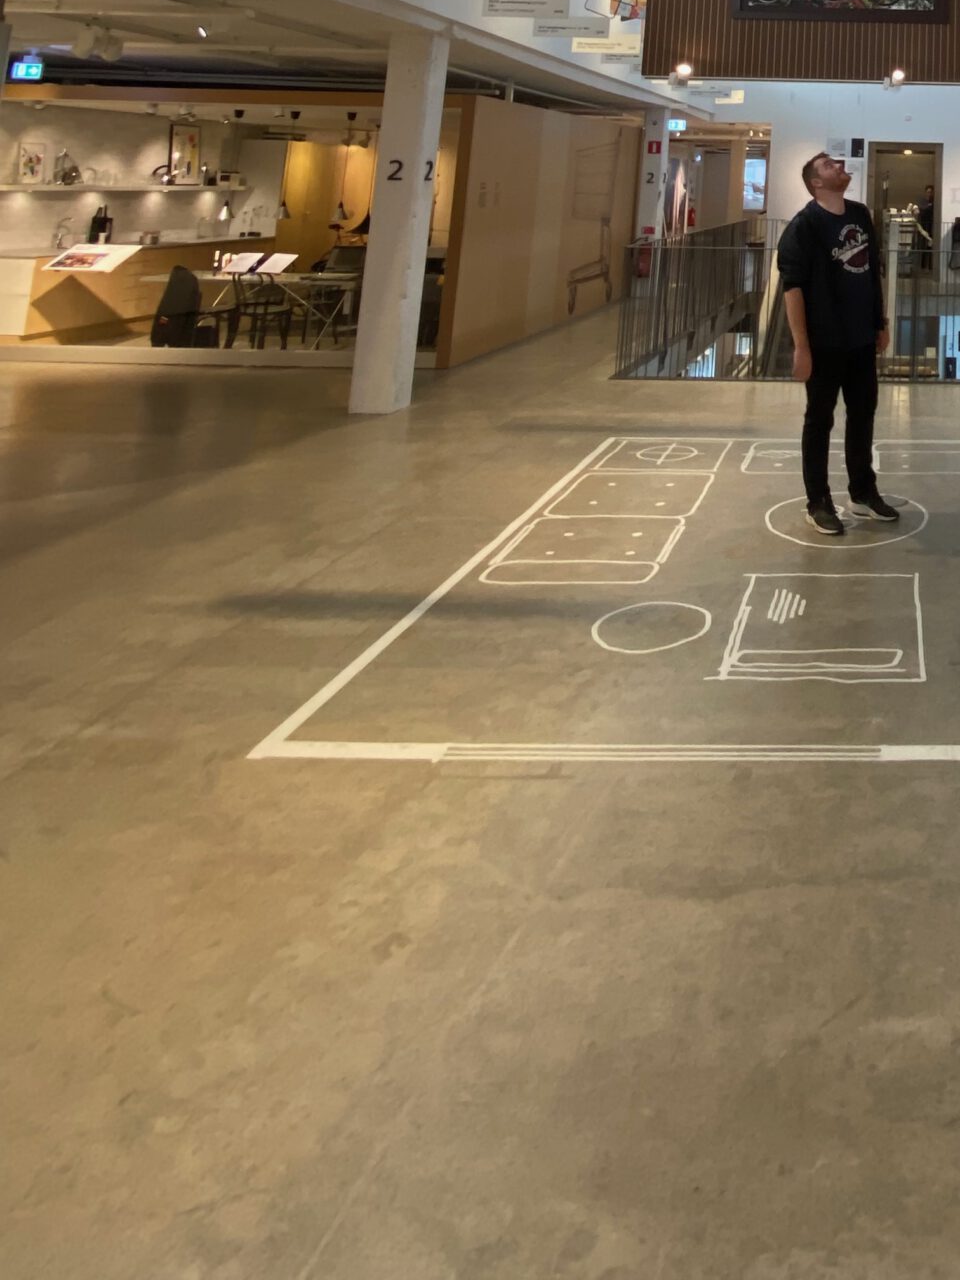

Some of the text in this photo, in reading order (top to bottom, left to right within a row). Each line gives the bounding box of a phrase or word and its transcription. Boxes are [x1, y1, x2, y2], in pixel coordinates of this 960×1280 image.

[387, 160, 403, 181] 2
[424, 160, 434, 181] 2
[646, 172, 655, 184] 2
